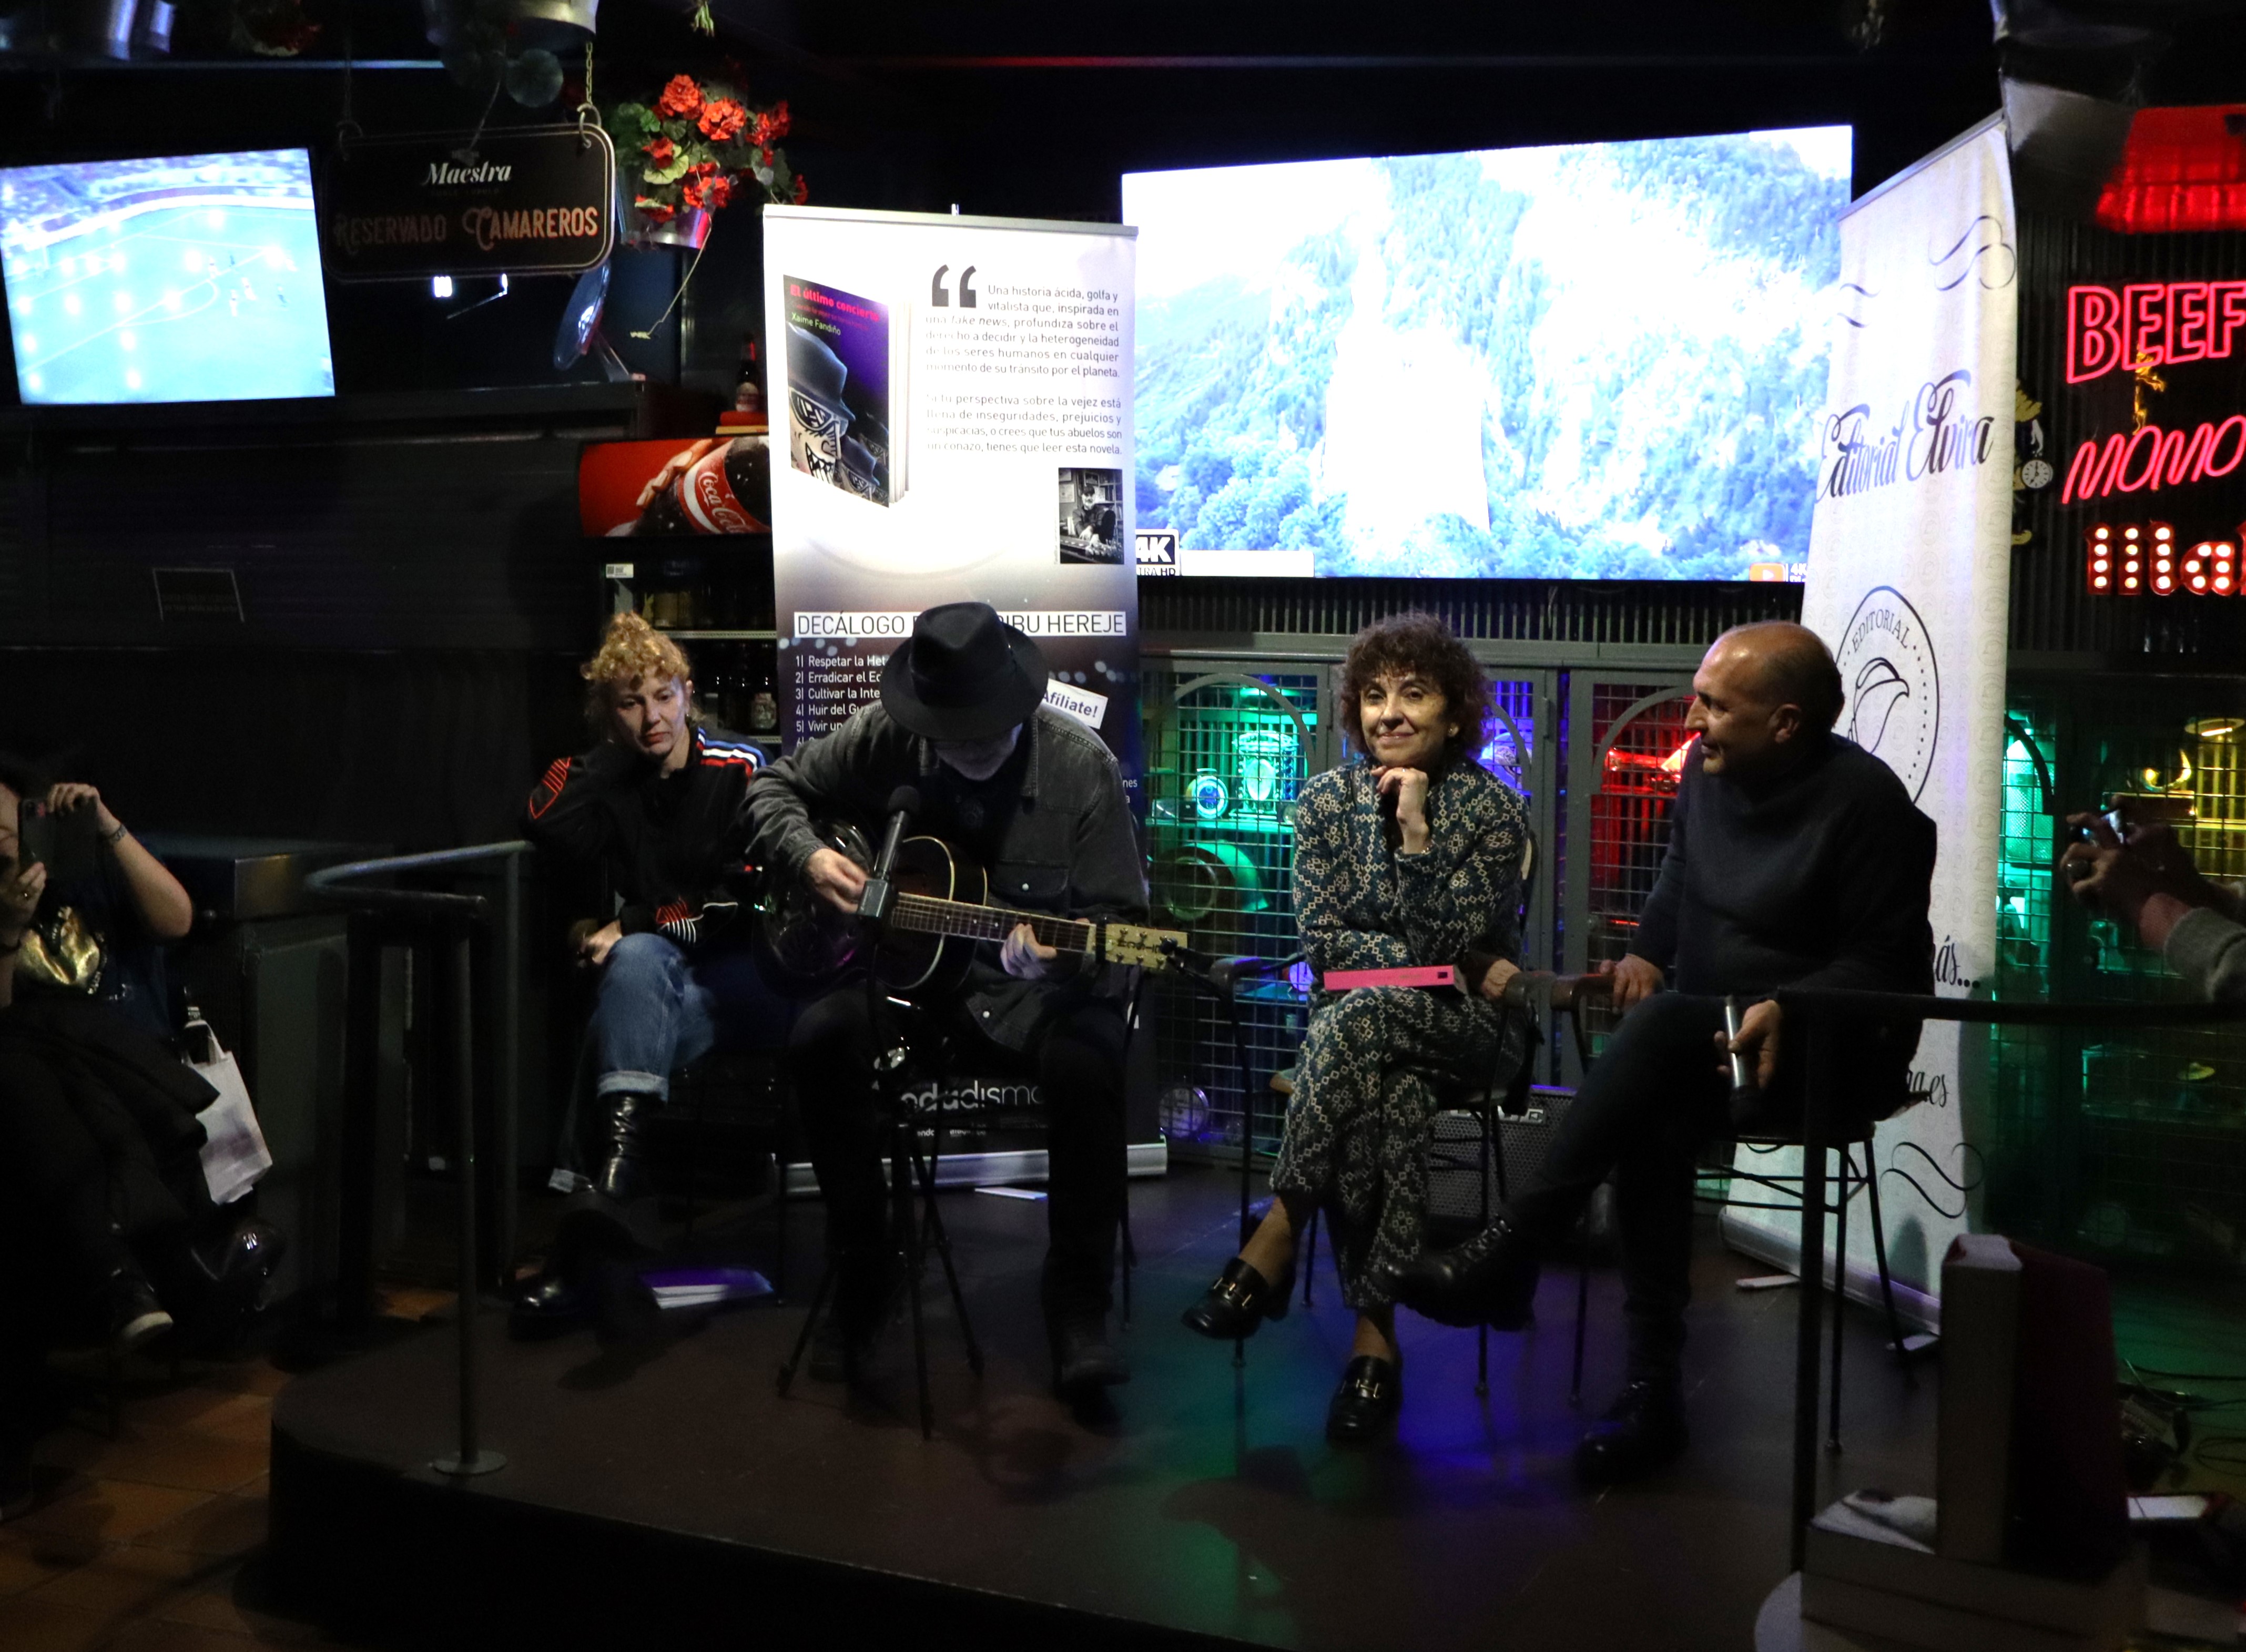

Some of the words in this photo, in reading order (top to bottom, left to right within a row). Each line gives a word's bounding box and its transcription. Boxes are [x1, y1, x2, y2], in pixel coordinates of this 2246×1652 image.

[421, 161, 512, 186] Maestra
[462, 206, 599, 251] CAMAREROS
[989, 285, 1009, 295] Una
[1013, 286, 1051, 297] historia
[1054, 287, 1084, 299] ácida,
[1087, 289, 1110, 301] golfa
[1113, 292, 1117, 303] y
[790, 284, 801, 297] El
[803, 287, 834, 308] último
[836, 300, 880, 322] concierto
[988, 302, 1029, 311] vitalista
[1032, 303, 1054, 314] que,
[1058, 304, 1104, 315] inspirada
[791, 312, 813, 327] Xaime
[815, 318, 841, 336] Fandiño
[951, 315, 975, 325] fake
[979, 318, 1010, 328] news,
[1014, 318, 1073, 329] profundiza
[1077, 321, 1106, 330] sobre
[1109, 322, 1118, 331] el
[982, 332, 1016, 341] decidir
[1020, 335, 1025, 344] y
[1029, 333, 1038, 343] la
[1042, 333, 1119, 346] heterogeneidad
[2067, 281, 2246, 384] BEEF
[964, 349, 994, 358] seres
[999, 348, 1050, 359] humanos
[1071, 351, 1119, 363] cualquier
[980, 363, 991, 372] de
[1010, 362, 1049, 374] tránsito
[1052, 367, 1068, 378] por
[1071, 366, 1080, 375] el
[1083, 368, 1120, 379] planeta.
[956, 395, 1019, 405] perspectiva
[1023, 396, 1053, 405] sobre
[1058, 396, 1068, 405] la
[1071, 397, 1097, 409] vejez
[1101, 397, 1121, 408] está
[960, 410, 972, 419] de
[977, 411, 1058, 423] inseguridades,
[1063, 412, 1114, 424] prejuicios
[1116, 416, 1121, 425] y
[1029, 429, 1047, 438] que
[1068, 428, 1104, 438] abuelos
[1814, 404, 1910, 503] Editorial
[1906, 370, 1995, 482] Elvira
[987, 443, 1017, 451] tienes
[1021, 444, 1039, 454] que
[1043, 443, 1062, 452] leer
[1066, 444, 1087, 453] esta
[1090, 445, 1122, 455] novela.
[1135, 537, 1172, 563] 4K
[2083, 521, 2246, 596] Ma
[1160, 567, 1176, 577] HD
[798, 610, 905, 635] DECÁLOGO
[998, 615, 1040, 633] IBU
[1048, 614, 1124, 633] HEREJE
[1852, 608, 1910, 654] EDITORIAL
[808, 655, 852, 669] Respetar
[855, 656, 864, 666] la
[867, 656, 887, 666] Het
[808, 671, 853, 683] Erradicar
[857, 671, 866, 682] el
[808, 688, 846, 699] Cultivar
[848, 688, 857, 698] la
[860, 688, 880, 699] Inte
[808, 704, 828, 715] Huir
[830, 704, 846, 715] del
[1042, 690, 1098, 718] Afíliate!
[808, 720, 828, 732] Vivir
[1935, 935, 1980, 988] ás...
